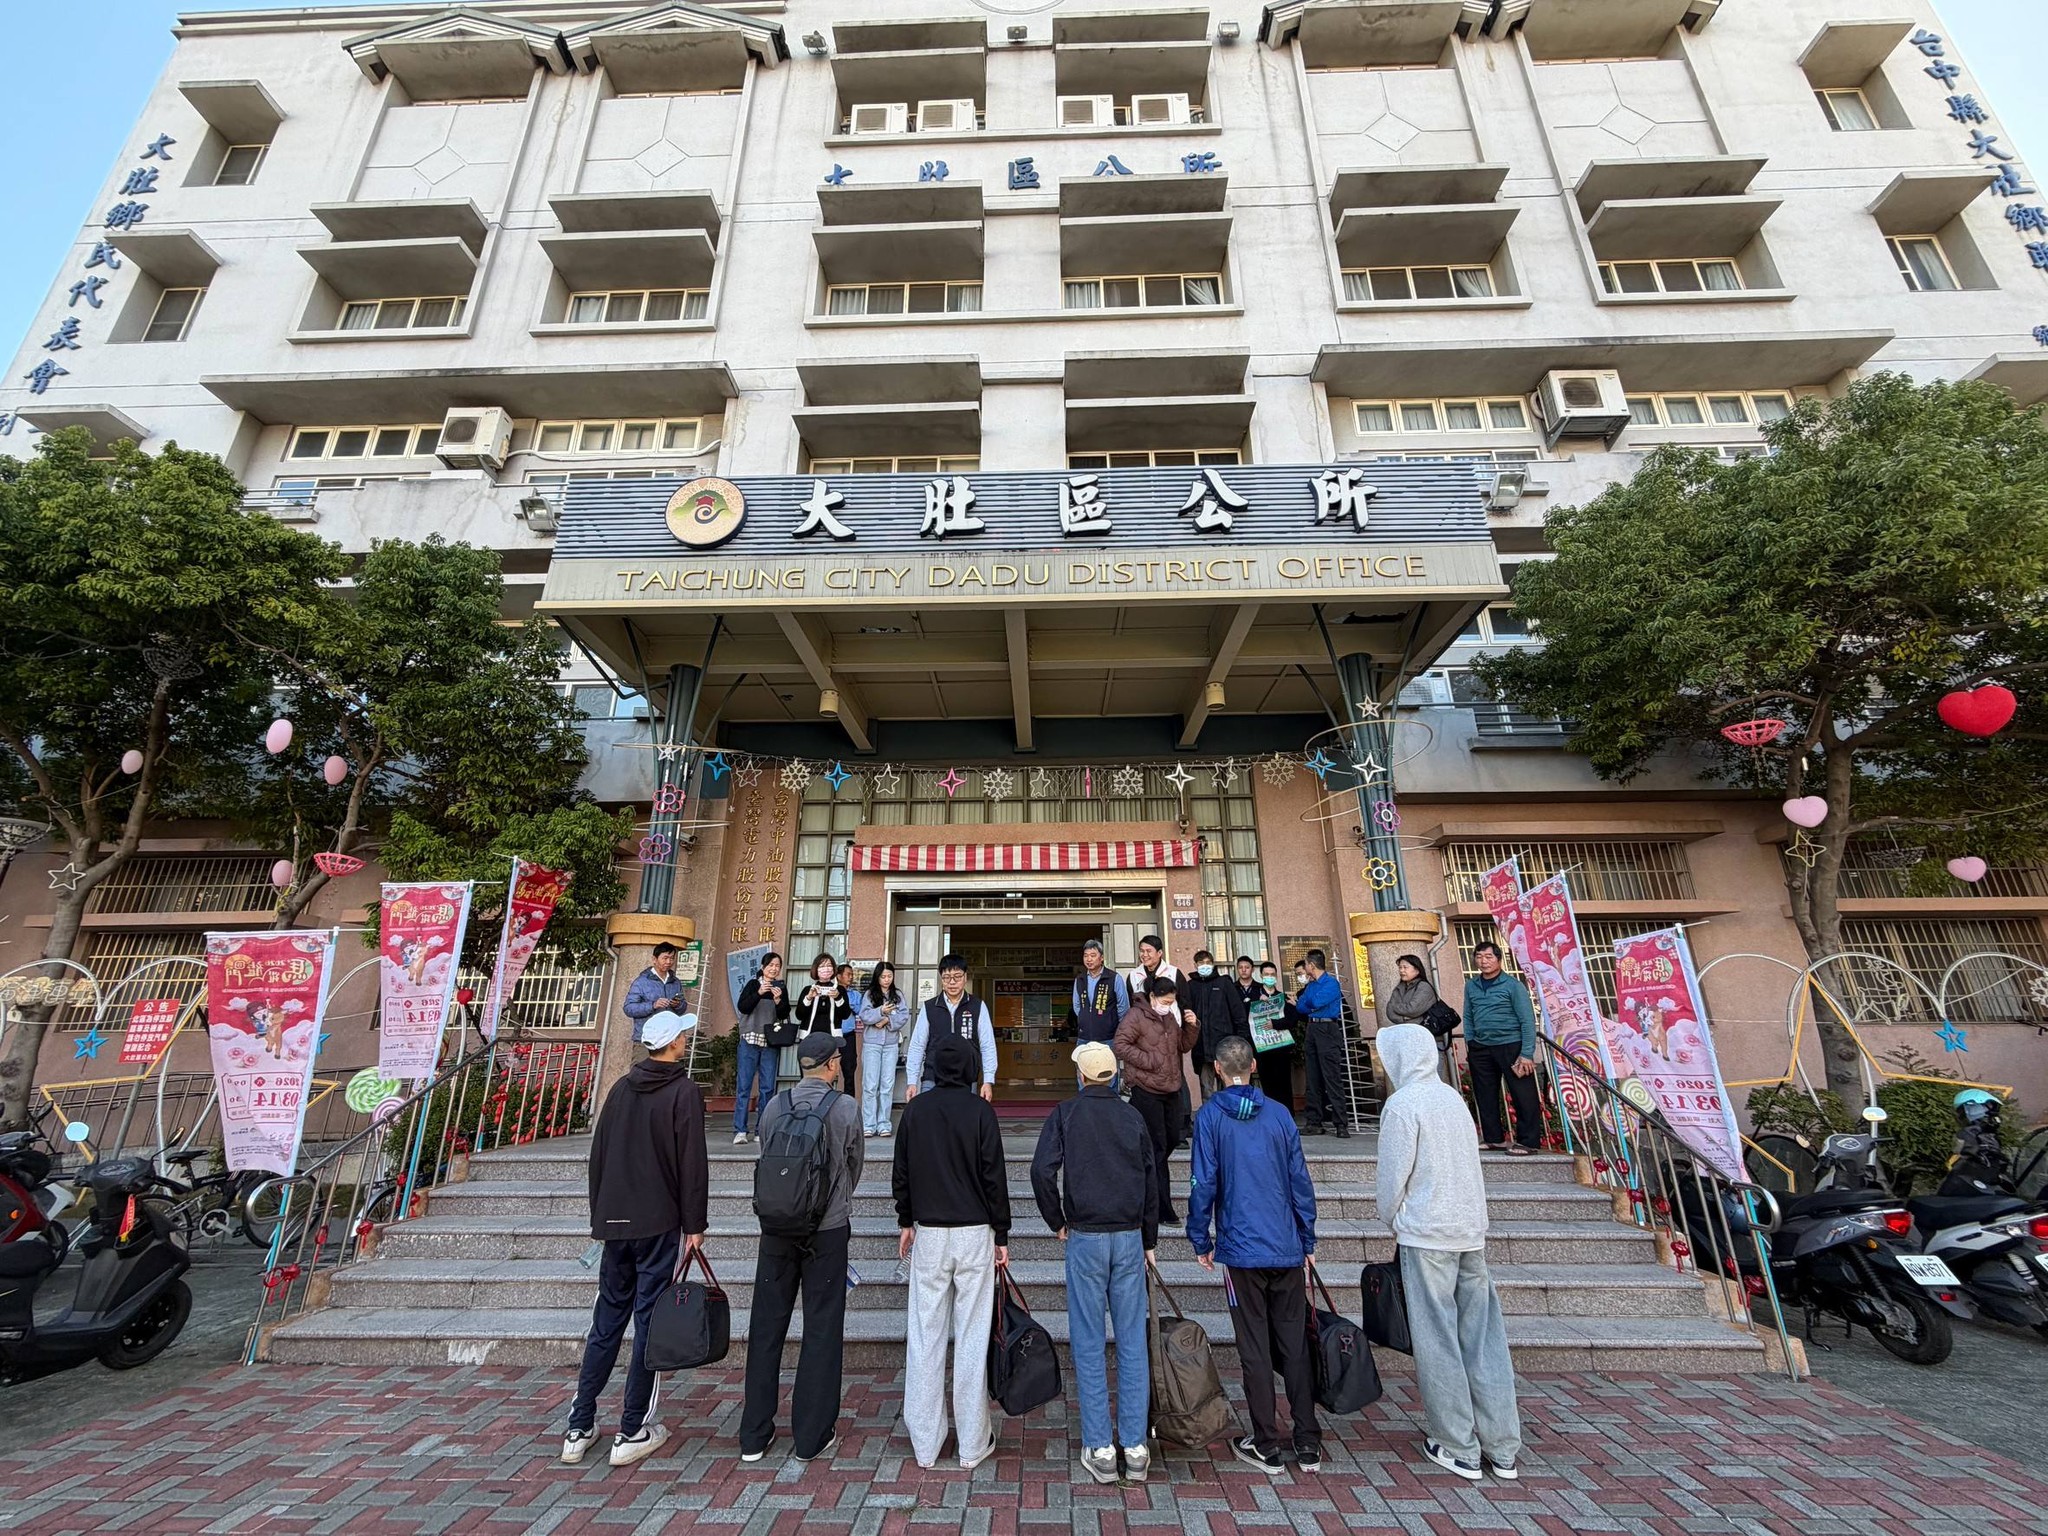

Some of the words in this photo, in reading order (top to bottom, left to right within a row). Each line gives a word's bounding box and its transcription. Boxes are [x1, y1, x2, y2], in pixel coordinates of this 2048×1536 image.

[24, 132, 177, 395] 大肚鄉民代表會
[792, 467, 1378, 542] 大肚區公所
[617, 567, 806, 592] TAICHUNG
[824, 565, 910, 589] CITY
[928, 562, 1050, 588] DADU
[1068, 557, 1258, 584] DISTRICT
[1277, 553, 1428, 579] OFFICE
[730, 790, 764, 950] 臺灣電力股份有限
[1176, 899, 1191, 907] 646
[1174, 918, 1197, 929] 646
[143, 1001, 170, 1013] 公告
